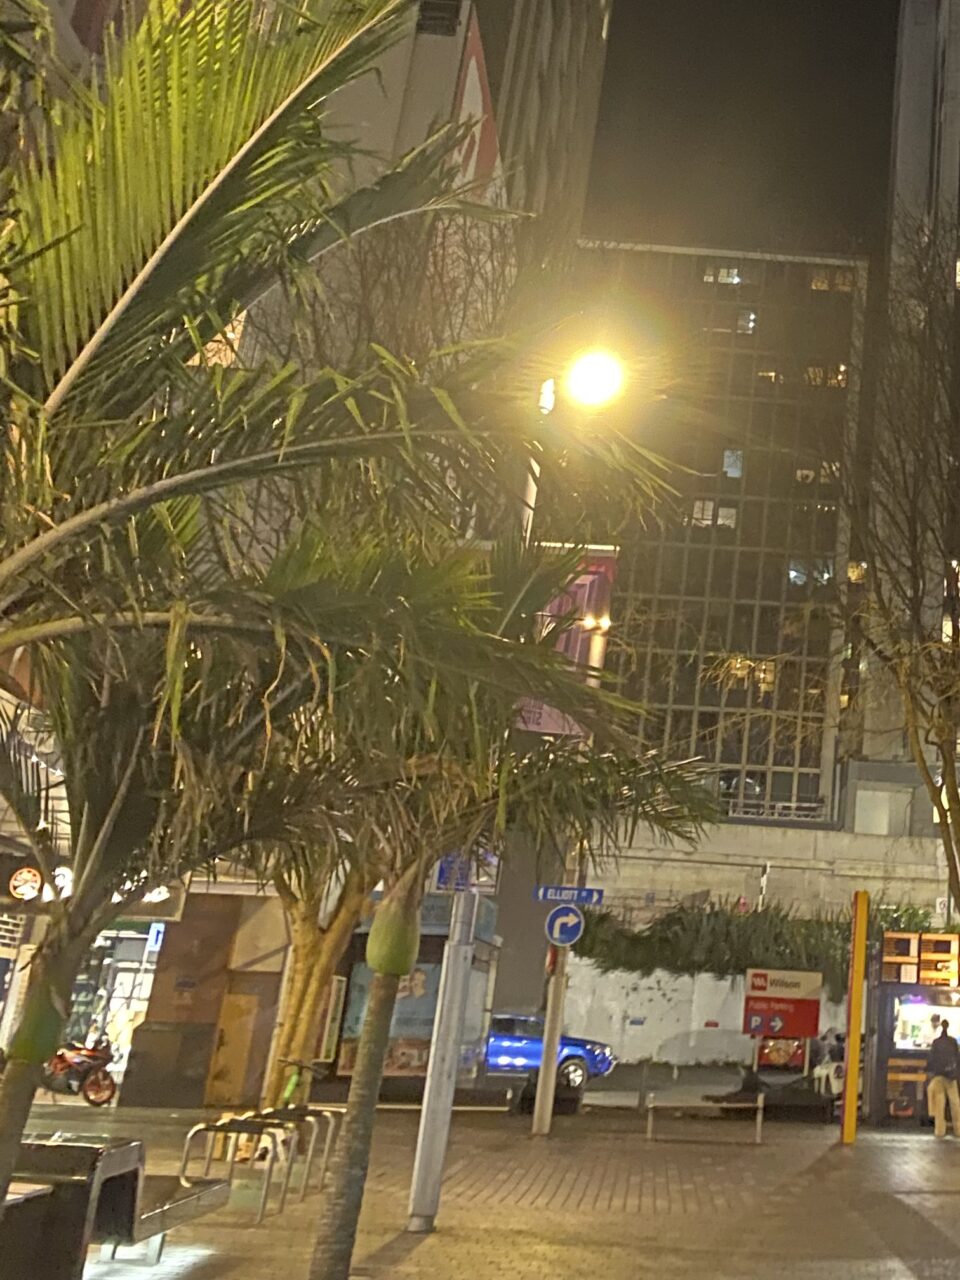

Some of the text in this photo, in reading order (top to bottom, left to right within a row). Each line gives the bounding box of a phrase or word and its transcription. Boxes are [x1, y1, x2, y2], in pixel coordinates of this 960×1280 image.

[547, 888, 578, 901] ELLIOTT
[769, 978, 801, 989] Wilson
[751, 1016, 762, 1029] P
